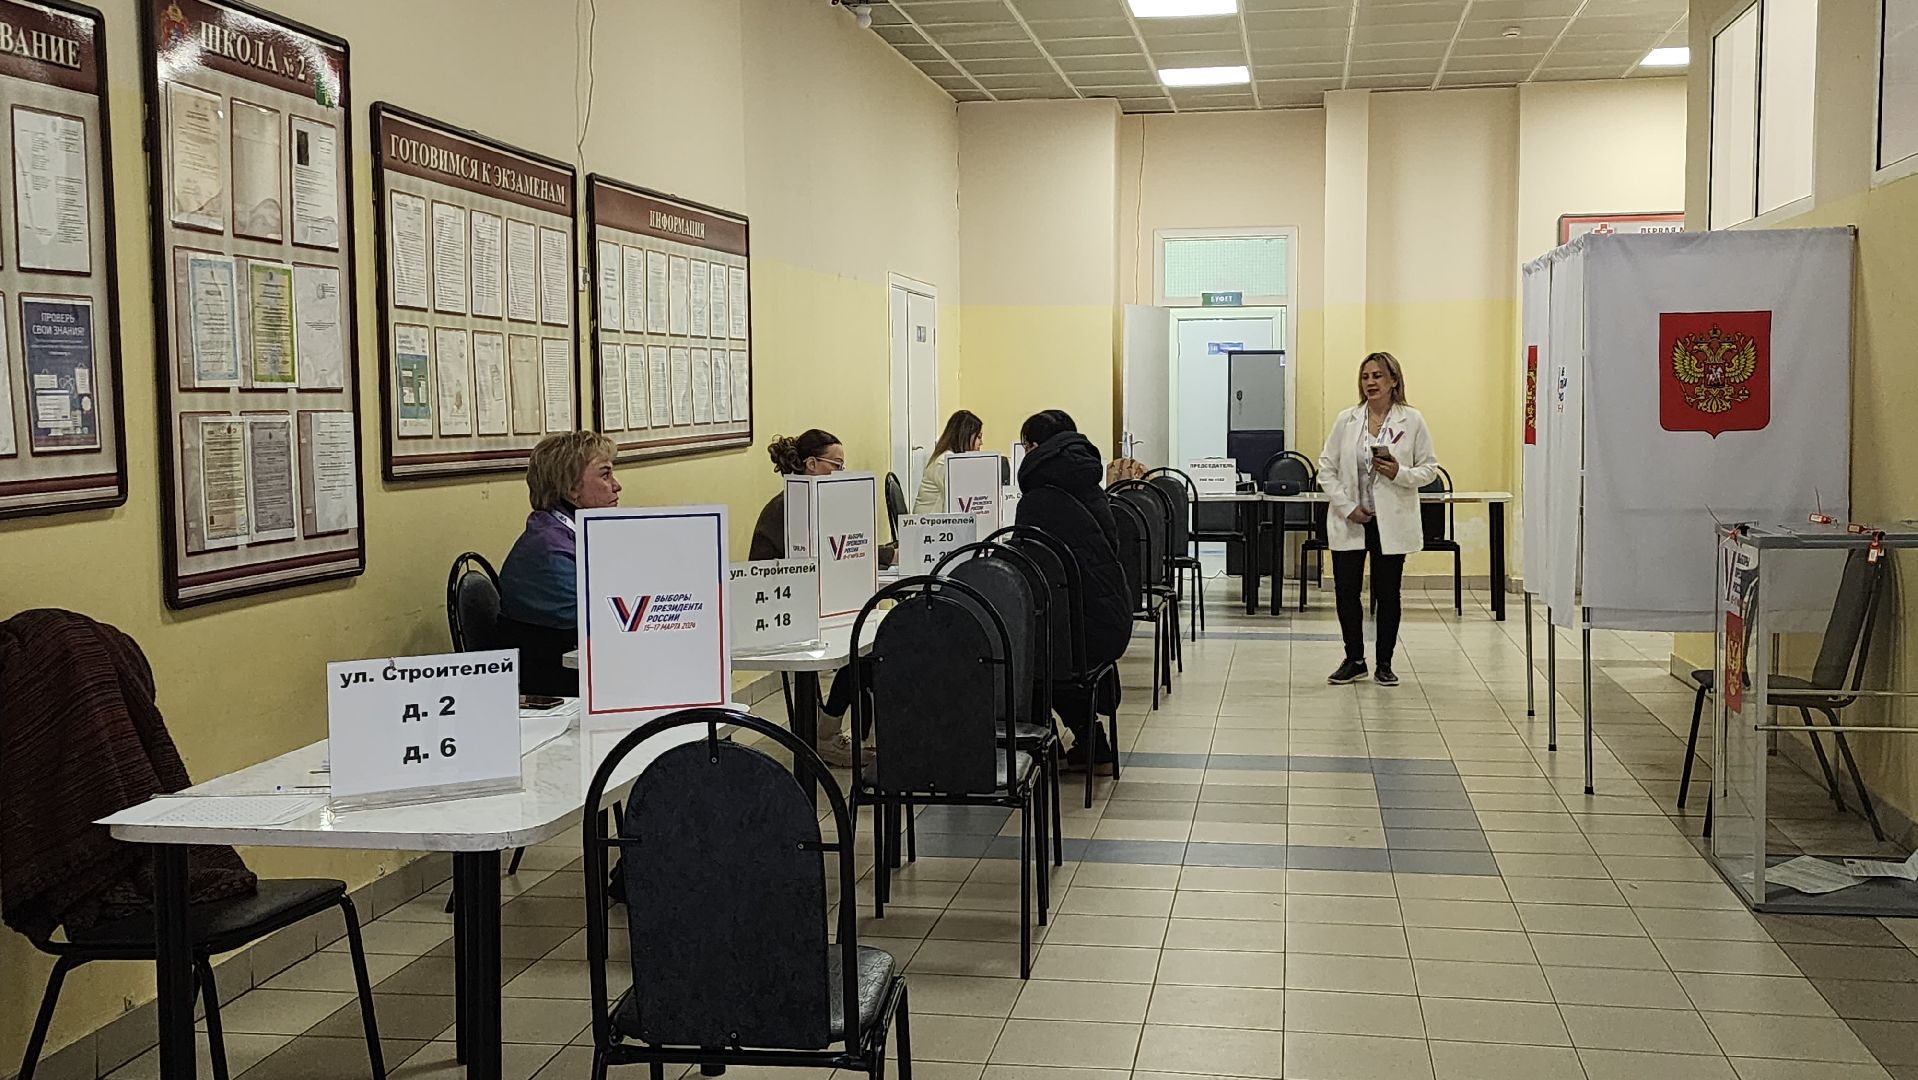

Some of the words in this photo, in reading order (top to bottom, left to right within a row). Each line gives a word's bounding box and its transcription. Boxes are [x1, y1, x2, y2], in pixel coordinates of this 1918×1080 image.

[199, 20, 278, 73] ШКОЛА
[390, 133, 479, 182] ГОТОВИМСЯ
[481, 161, 493, 185] К
[493, 164, 567, 205] ЭКЗАМЕНАМ
[649, 209, 705, 239] ИНФОРМАЦИЯ
[41, 312, 76, 323] ПРОВЕРЬ
[902, 518, 917, 528] ул.
[920, 516, 975, 526] Строителей
[923, 534, 936, 544] д.
[938, 532, 954, 542] 20
[923, 553, 936, 563] д.
[729, 569, 747, 581] ул.
[750, 562, 816, 578] Строителей
[654, 593, 692, 603] ВЫБОРЫ
[755, 591, 769, 604] д.
[773, 585, 792, 600] 14
[650, 602, 703, 613] ПРЕЗИДЕНТА
[646, 613, 681, 623] РОССИИ
[660, 623, 681, 631] МАРТА
[681, 621, 696, 630] 2024
[755, 618, 769, 632] д.
[774, 612, 791, 627] 18
[340, 671, 375, 688] ул.
[382, 657, 514, 683] Строителей
[402, 703, 429, 723] д.
[438, 695, 456, 717] 2
[403, 745, 430, 764] д.
[440, 737, 457, 758] 6
